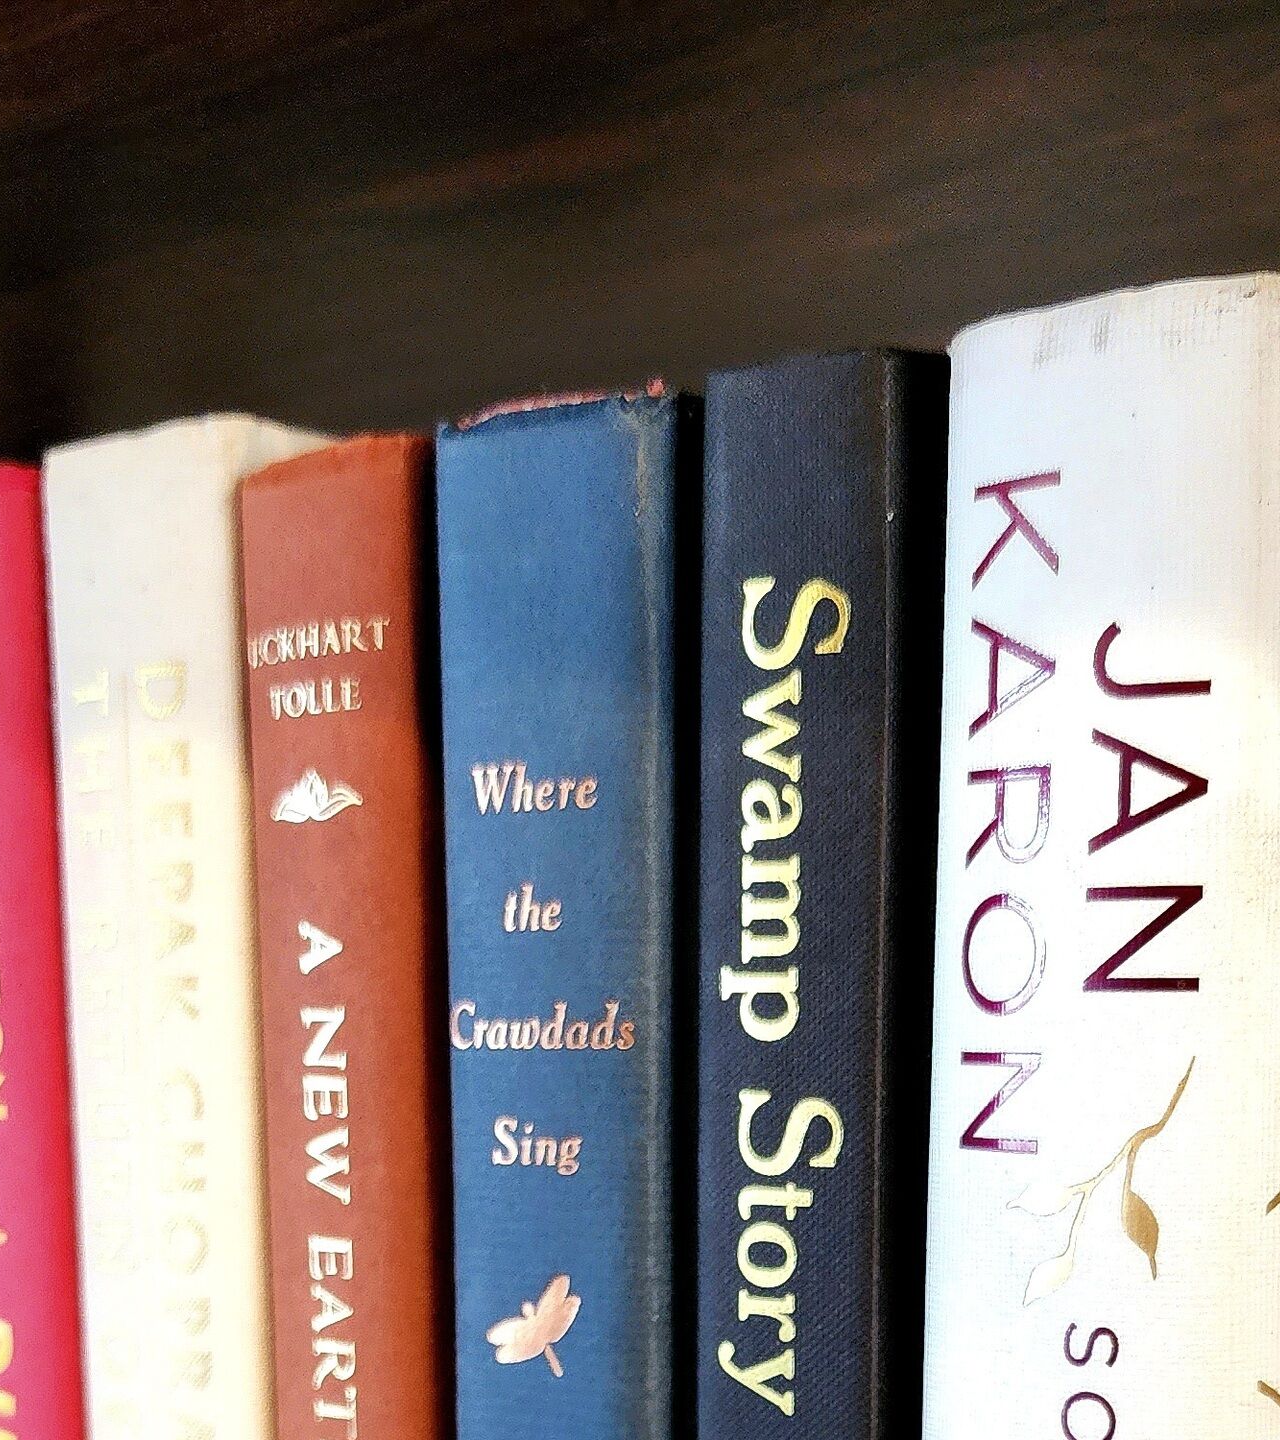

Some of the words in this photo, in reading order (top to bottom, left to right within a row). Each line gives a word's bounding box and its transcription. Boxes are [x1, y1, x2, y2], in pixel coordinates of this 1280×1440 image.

[270, 674, 363, 721] TOLLE
[134, 656, 201, 1027] DEEPAK
[470, 757, 599, 816] Where
[719, 574, 853, 1044] Swamp
[958, 466, 1063, 1156] KARON
[1081, 620, 1213, 995] JAN
[297, 919, 345, 976] A
[502, 880, 564, 935] the
[450, 999, 638, 1052] Crawdads
[298, 1004, 352, 1207] NEW
[491, 1113, 585, 1177] Sing
[717, 1086, 846, 1418] Story
